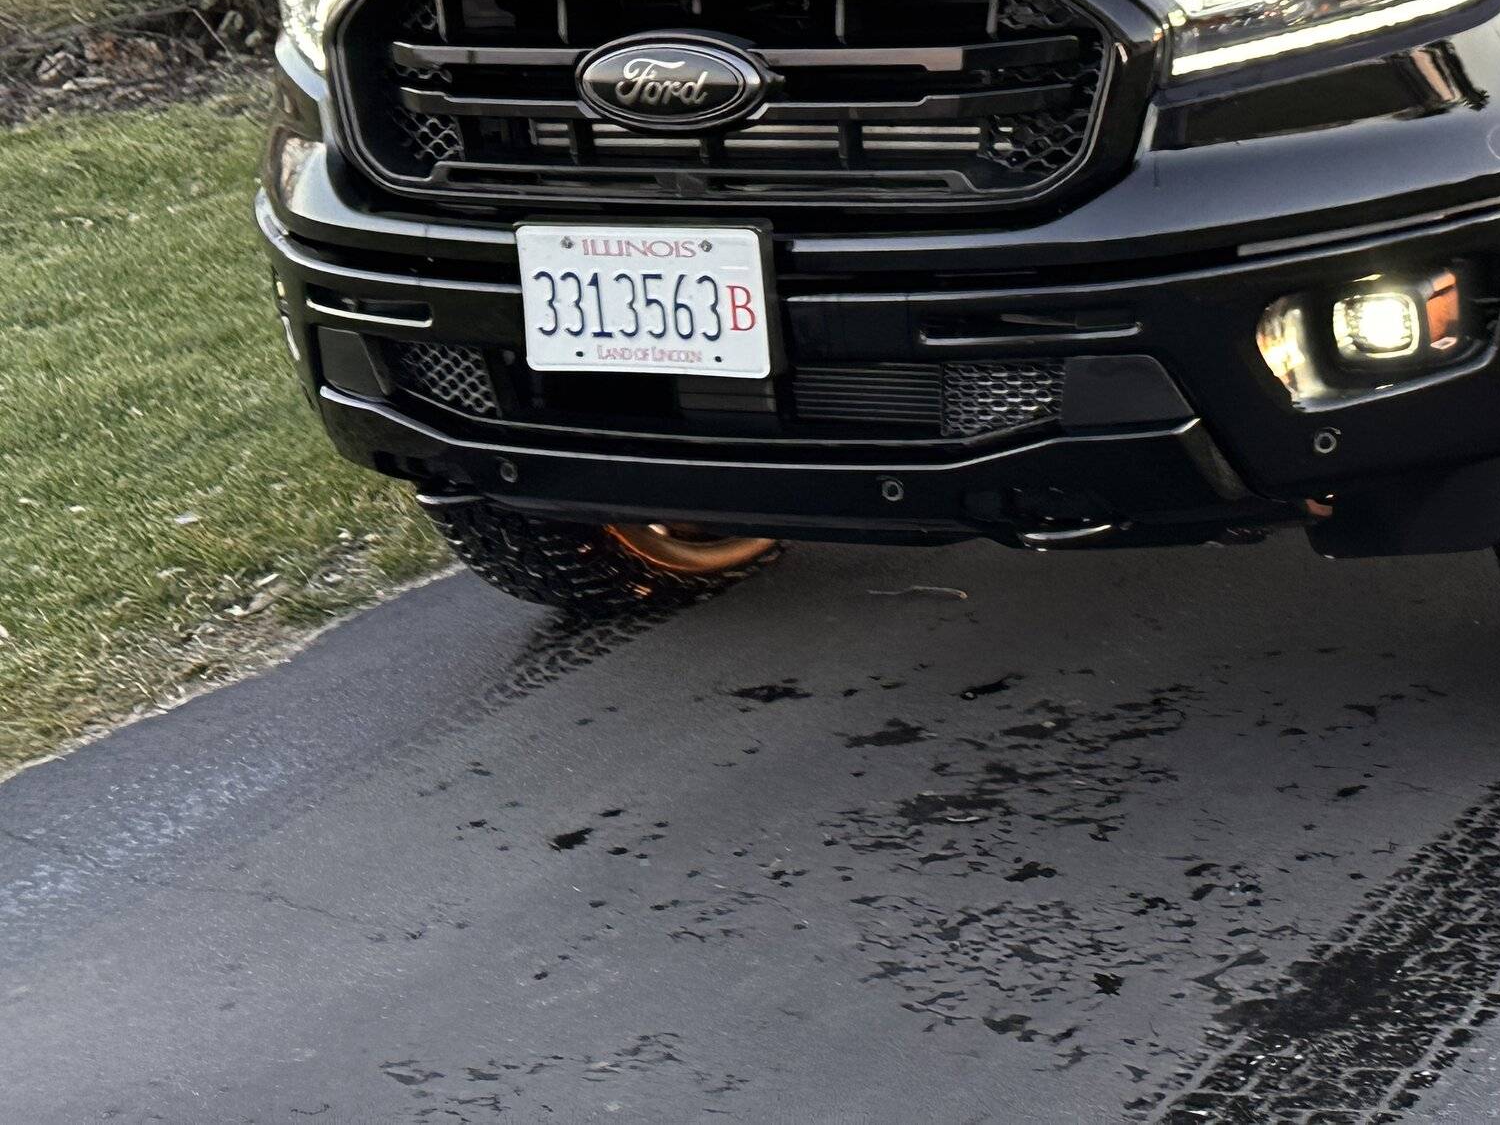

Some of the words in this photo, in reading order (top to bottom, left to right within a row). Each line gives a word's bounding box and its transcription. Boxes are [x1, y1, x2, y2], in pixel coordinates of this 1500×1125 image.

[615, 58, 708, 106] Ford
[582, 238, 697, 258] ILLINOIS
[533, 271, 722, 342] 3313563
[726, 285, 757, 332] B
